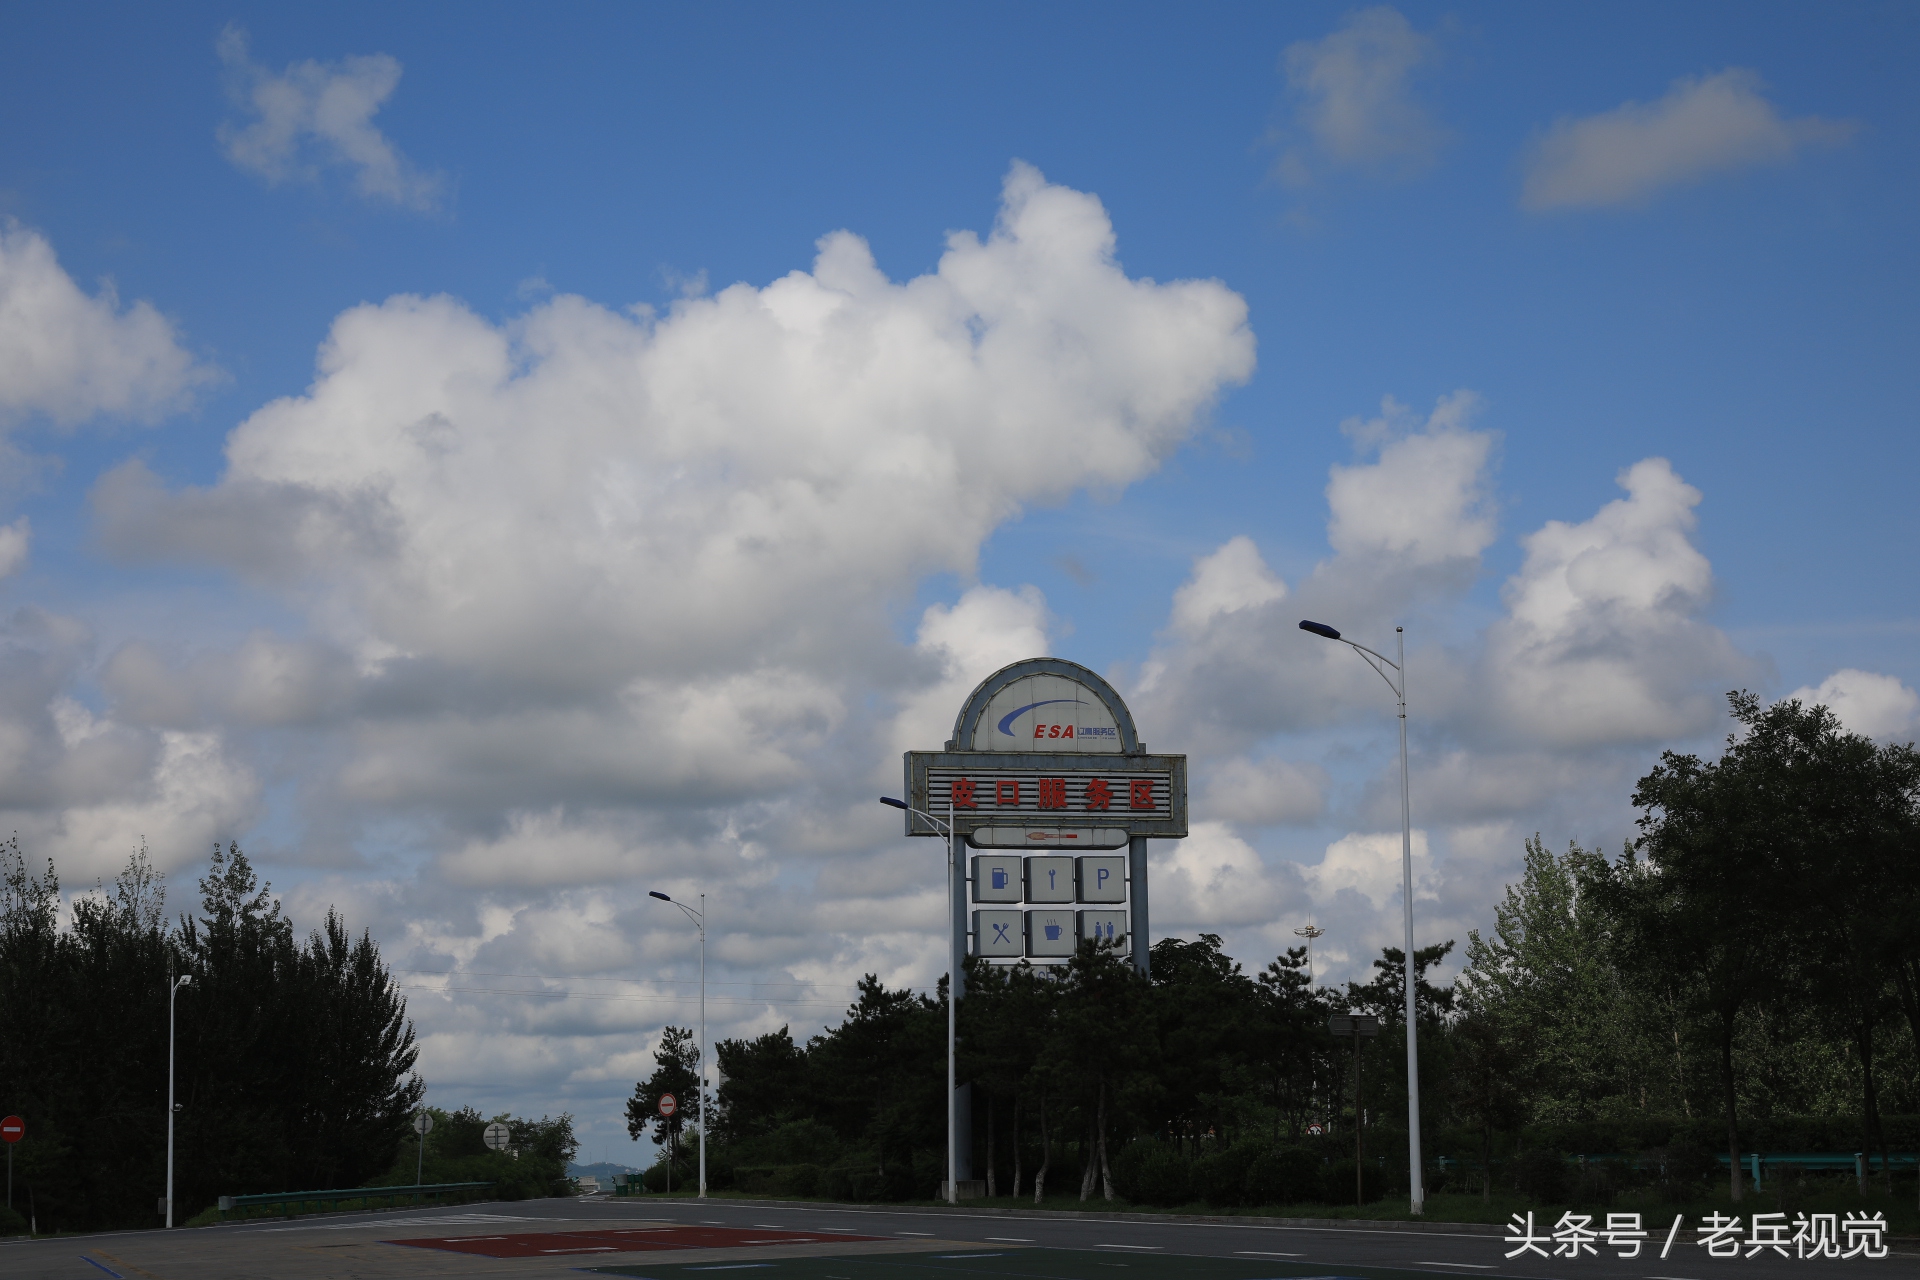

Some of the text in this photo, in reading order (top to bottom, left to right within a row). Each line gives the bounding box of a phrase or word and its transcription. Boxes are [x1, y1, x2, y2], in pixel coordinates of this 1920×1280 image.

[1034, 724, 1074, 739] ESA
[951, 777, 1156, 809] 皮口服务区
[1097, 868, 1110, 890] P
